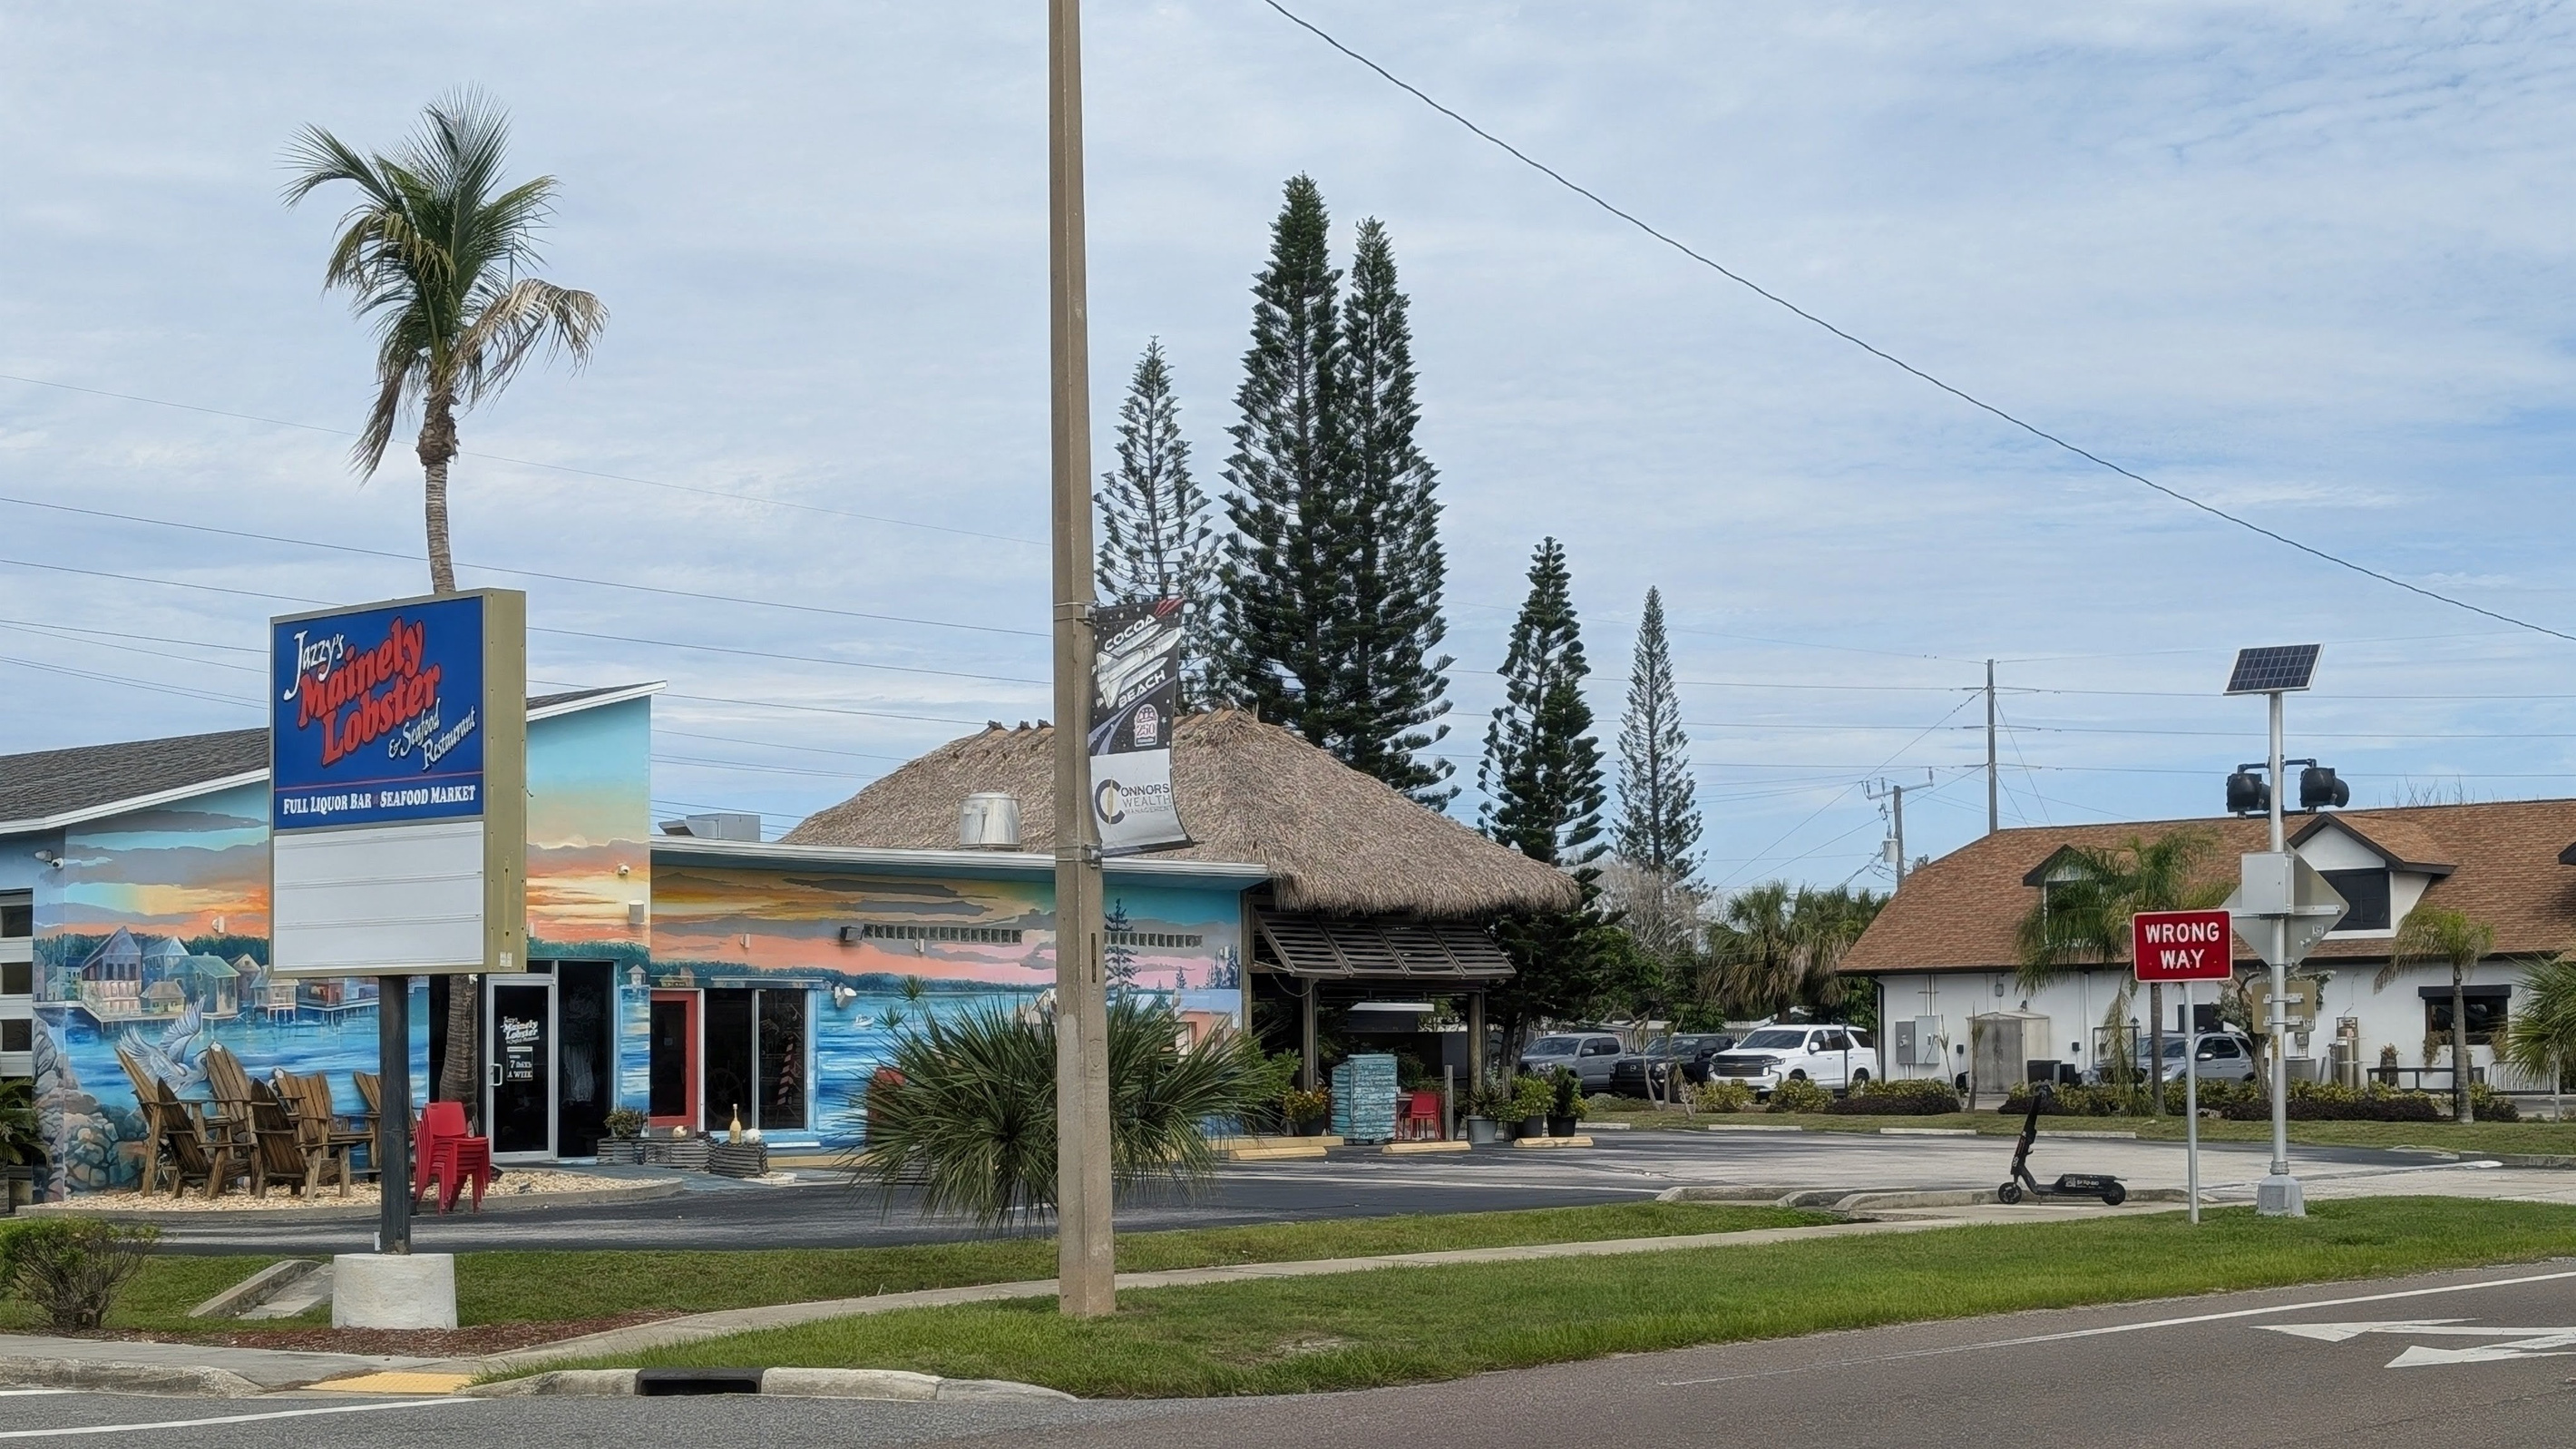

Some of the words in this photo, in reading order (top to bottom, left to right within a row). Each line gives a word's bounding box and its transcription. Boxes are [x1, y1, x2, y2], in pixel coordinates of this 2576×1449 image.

[1104, 614, 1156, 652] COCOA
[283, 630, 345, 701] Jazzy's
[298, 617, 424, 728] Mainely
[1117, 670, 1166, 709] BEACH
[322, 663, 441, 767] Lobster
[388, 738, 402, 759] &
[400, 697, 441, 757] Seafood
[422, 705, 476, 770] Restaurant
[283, 798, 309, 815] FULL
[310, 795, 348, 815] LIQUOR
[350, 792, 373, 809] BAR
[380, 788, 429, 808] SEAFOOD
[431, 785, 476, 804] MARKET
[1122, 795, 1172, 808] WEALTH
[2144, 922, 2220, 944] WRONG
[2160, 948, 2205, 970] WAY
[510, 1060, 515, 1069] 7
